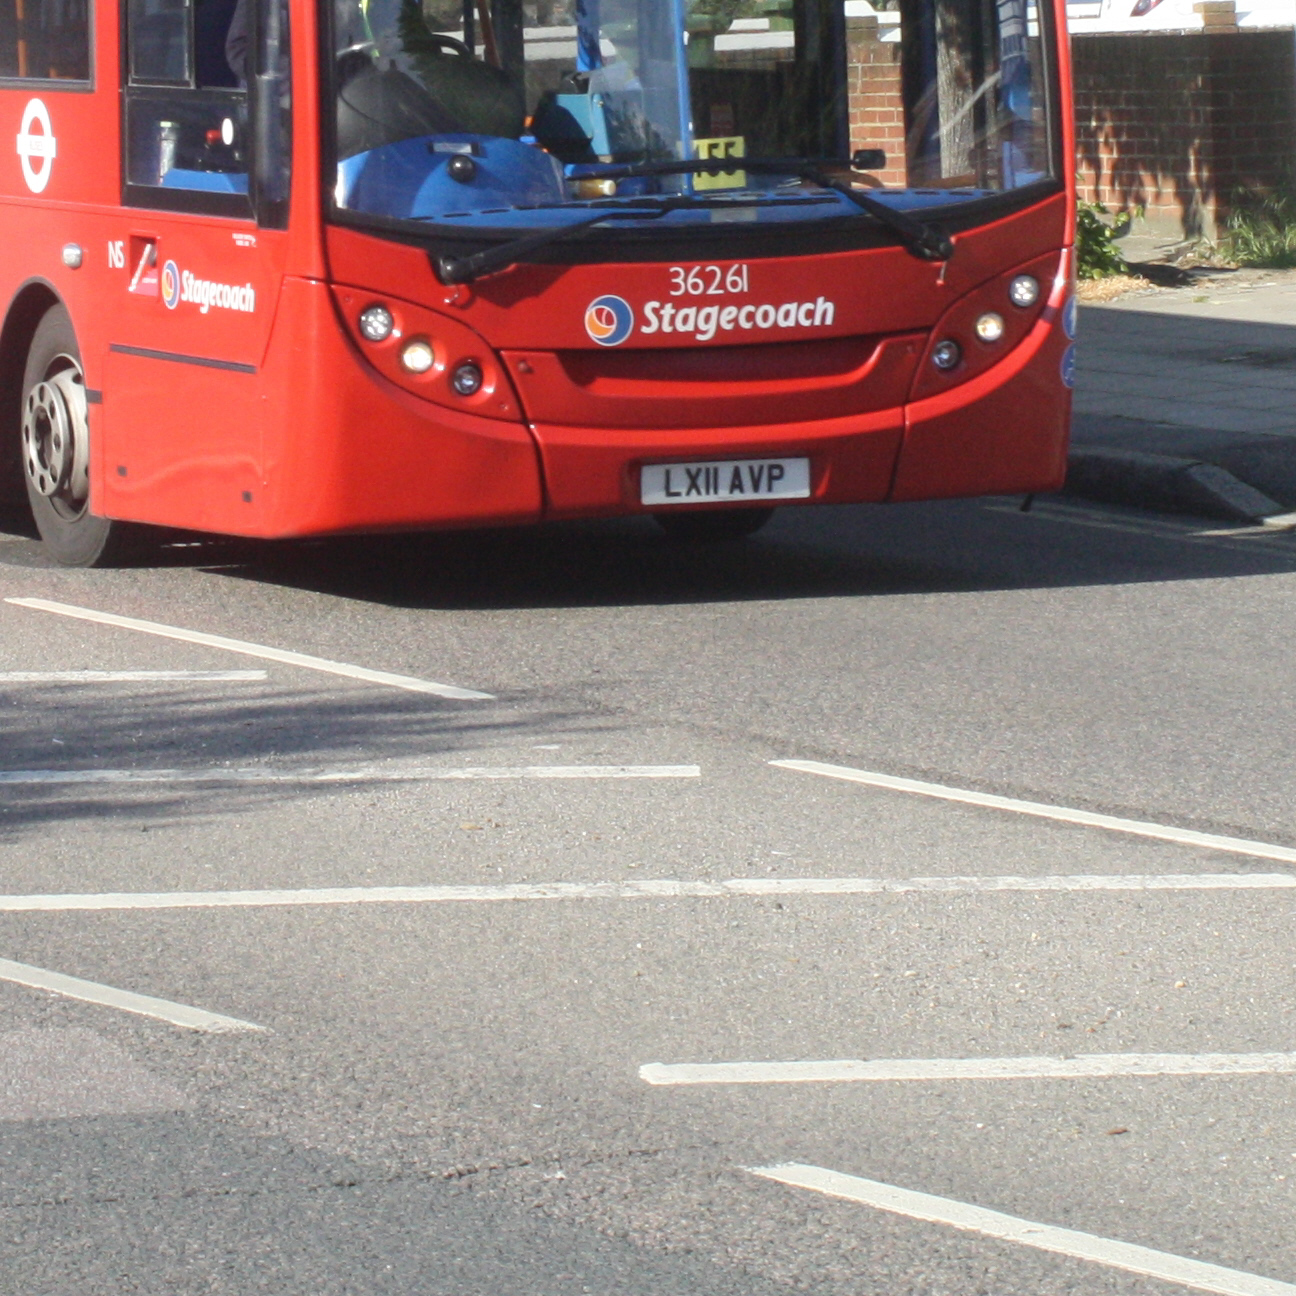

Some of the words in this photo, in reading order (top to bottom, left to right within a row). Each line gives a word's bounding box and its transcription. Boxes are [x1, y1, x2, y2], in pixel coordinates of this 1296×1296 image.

[108, 240, 125, 269] NS
[180, 269, 256, 315] Stagecoach
[669, 264, 749, 296] 36261
[640, 296, 835, 341] Stagecoach
[665, 467, 719, 498] LX11
[729, 463, 785, 496] AVP
